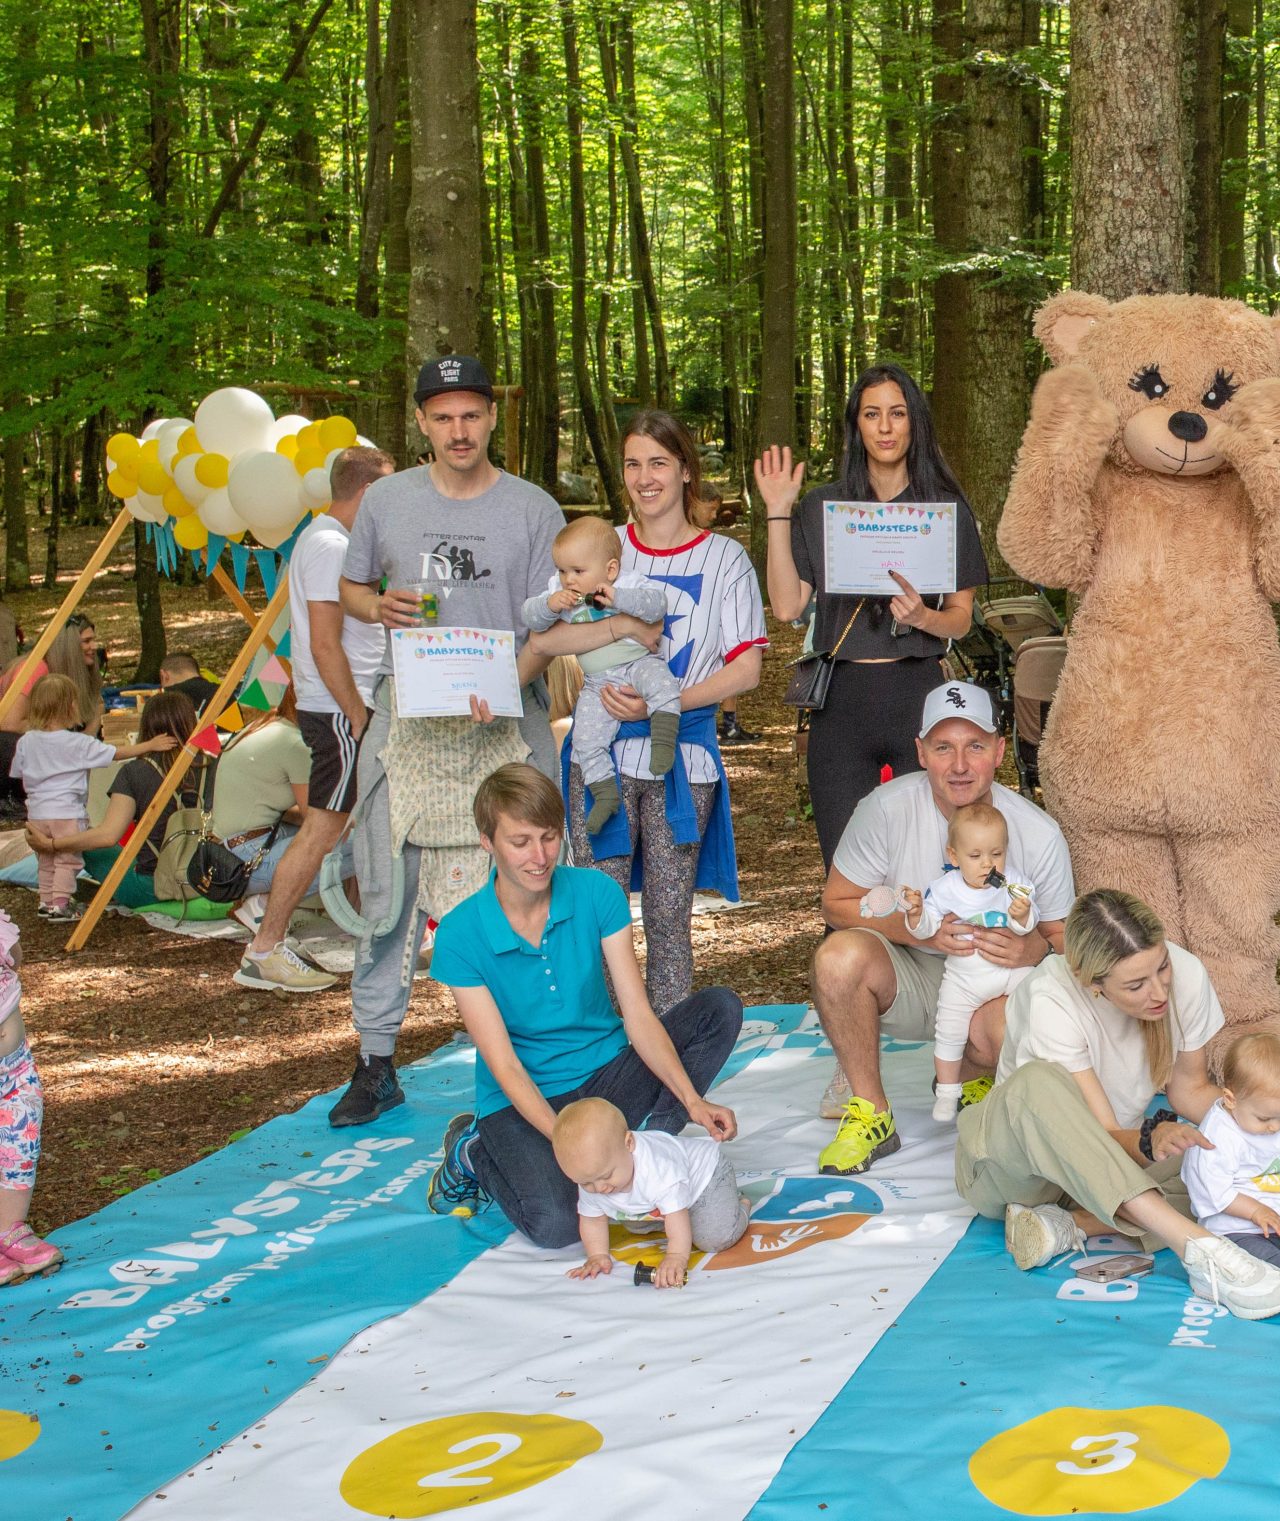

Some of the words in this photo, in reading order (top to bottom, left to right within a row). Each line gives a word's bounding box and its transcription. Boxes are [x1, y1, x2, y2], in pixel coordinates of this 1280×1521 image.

[438, 360, 452, 370] CITY
[440, 369, 460, 377] FLIGHT
[858, 523, 919, 532] BABYSTEPS
[423, 532, 452, 540] FITTER
[426, 647, 484, 656] BABYSTEPS
[104, 1272, 256, 1352] program
[1168, 1296, 1230, 1349] prog
[1055, 1431, 1138, 1476] 3
[416, 1433, 522, 1488] 2
